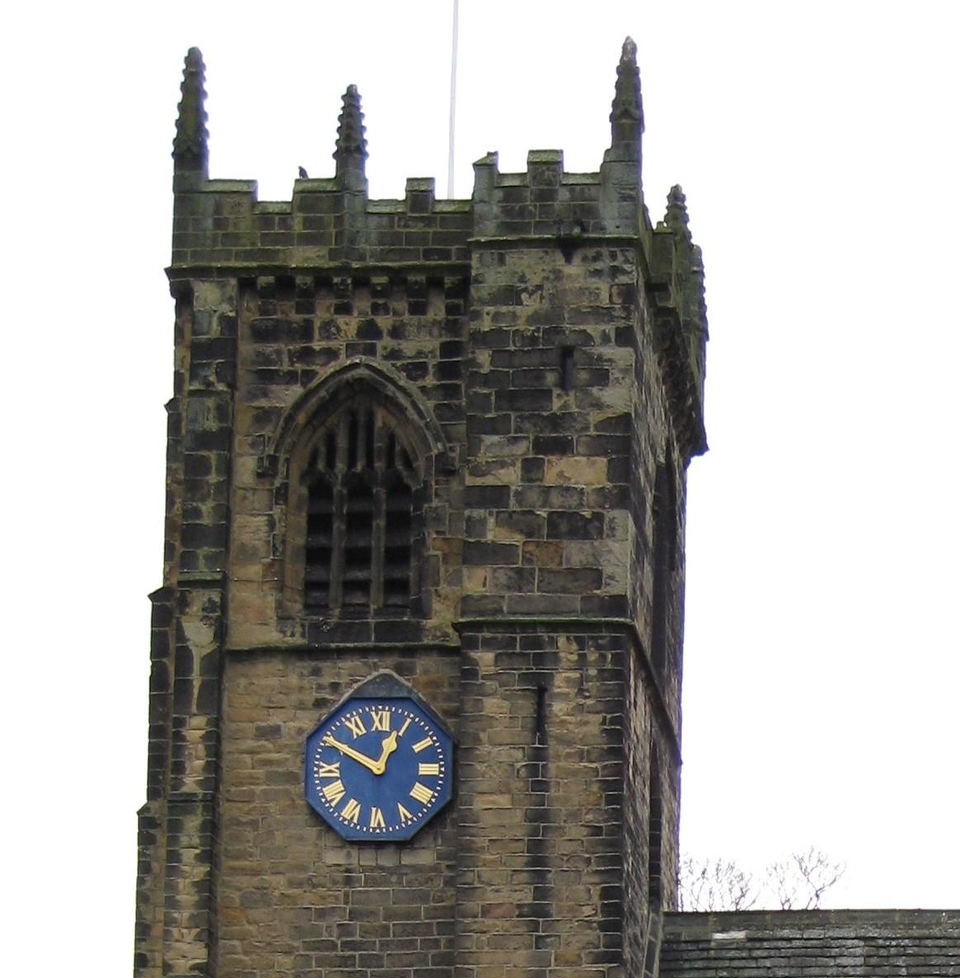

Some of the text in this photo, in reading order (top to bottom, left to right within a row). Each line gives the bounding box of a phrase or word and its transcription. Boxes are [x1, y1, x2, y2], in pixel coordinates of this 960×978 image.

[345, 716, 368, 739] XI
[370, 711, 391, 732] XII
[398, 718, 412, 737] I
[412, 737, 434, 753] II
[319, 762, 340, 778] IX
[418, 762, 440, 776] III
[322, 779, 347, 808] VIII
[409, 782, 435, 805] IIII
[341, 798, 362, 824] VII
[370, 807, 386, 829] VI
[397, 802, 413, 823] V
